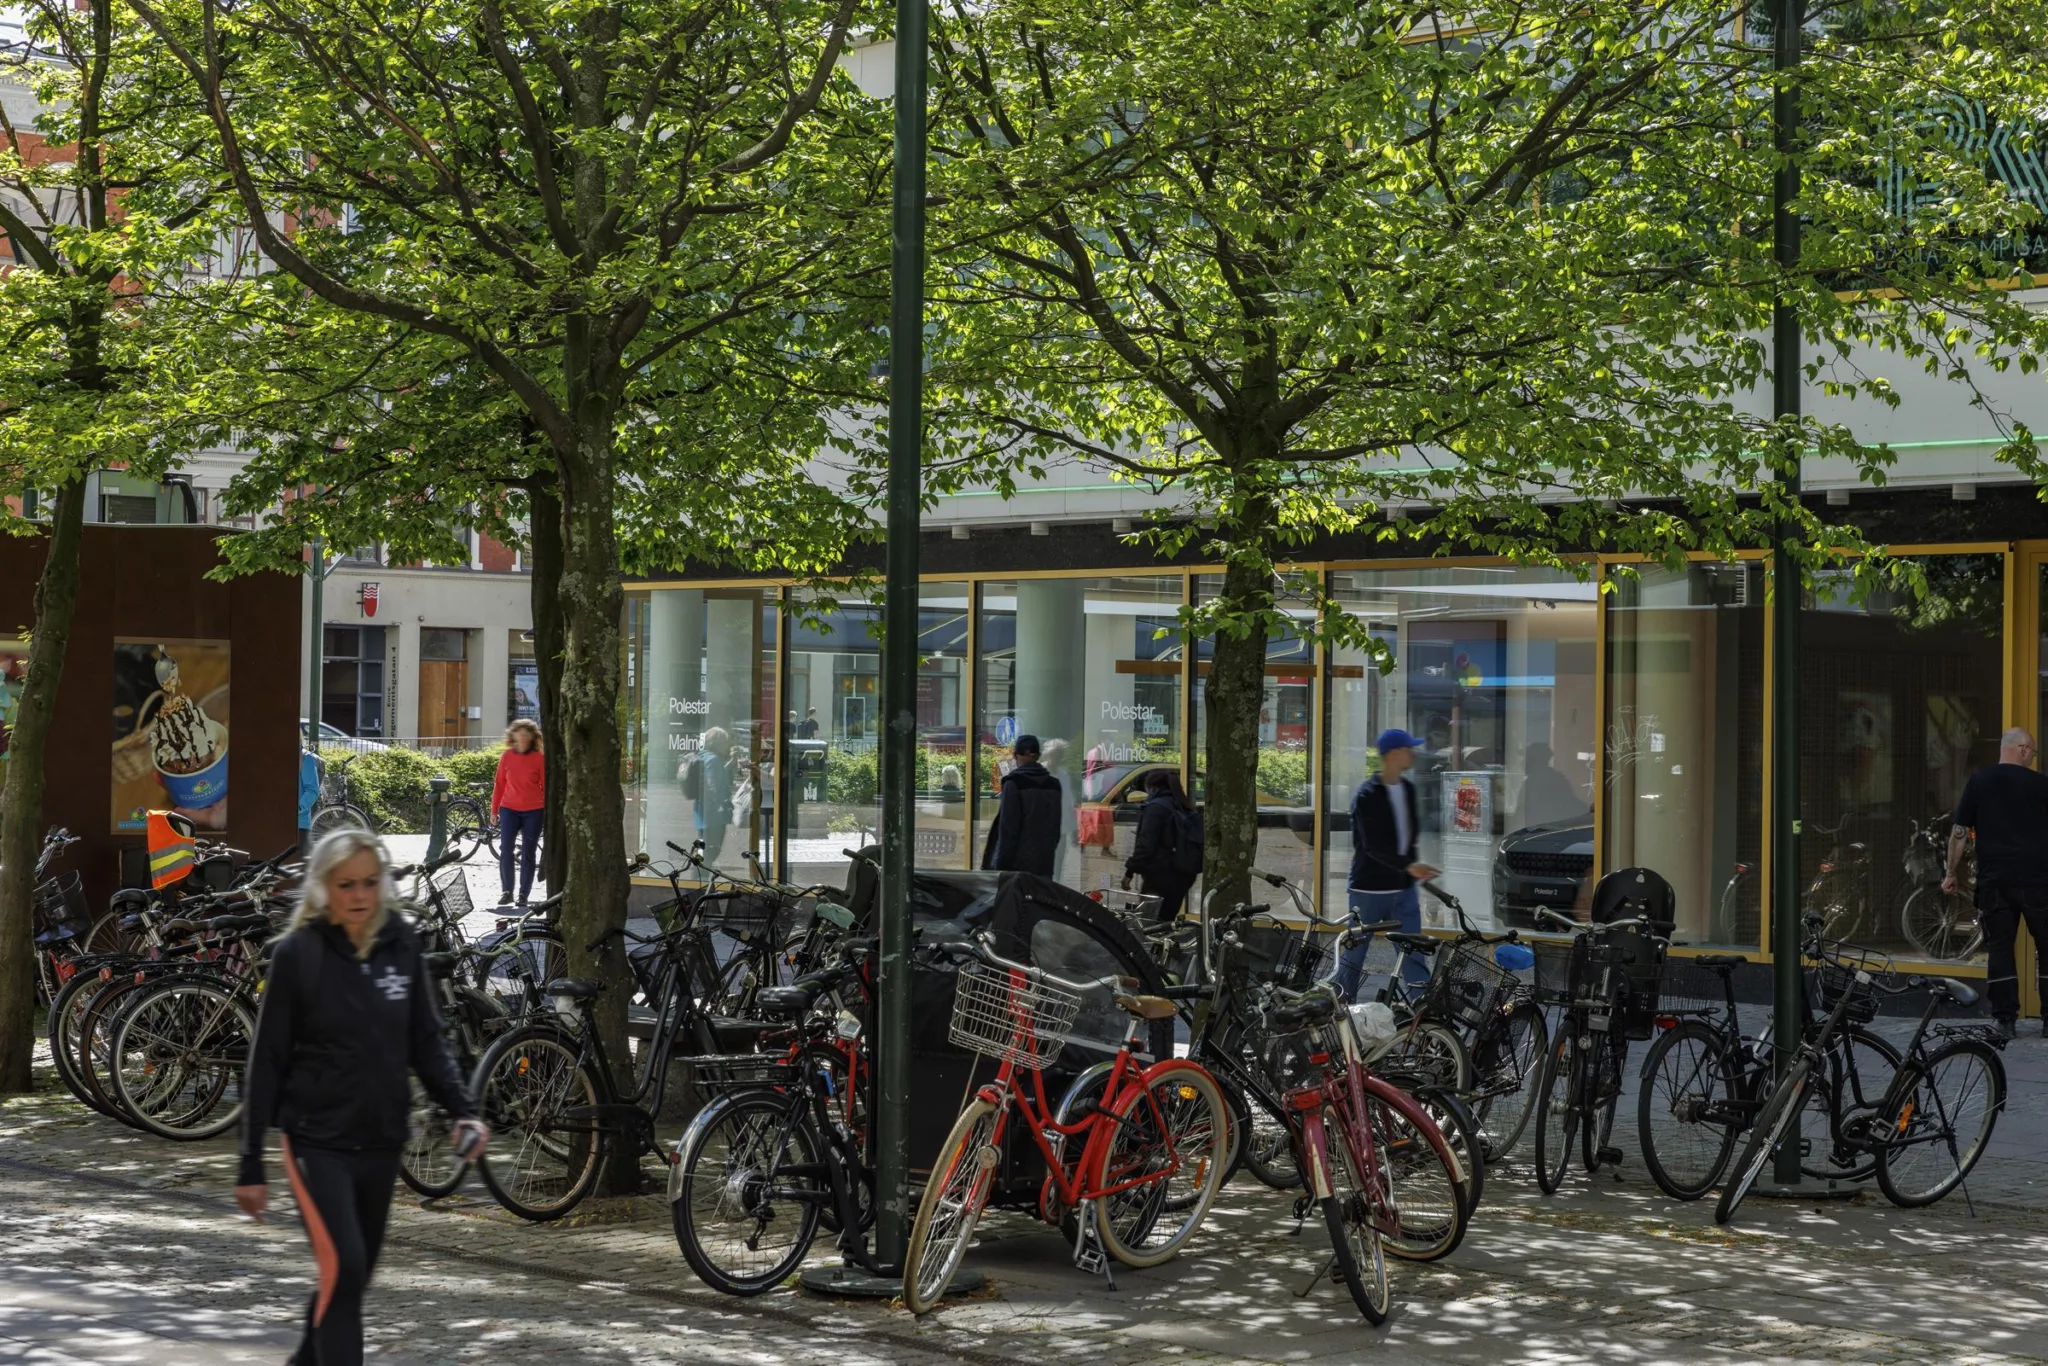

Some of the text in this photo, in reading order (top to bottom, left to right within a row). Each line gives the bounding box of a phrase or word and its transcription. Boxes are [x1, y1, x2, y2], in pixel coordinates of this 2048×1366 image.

[1948, 234, 2047, 262] MPISA
[669, 697, 712, 714] Polestar
[1101, 701, 1156, 720] Polestar
[668, 733, 706, 751] Malmö
[1100, 742, 1147, 762] Malmö
